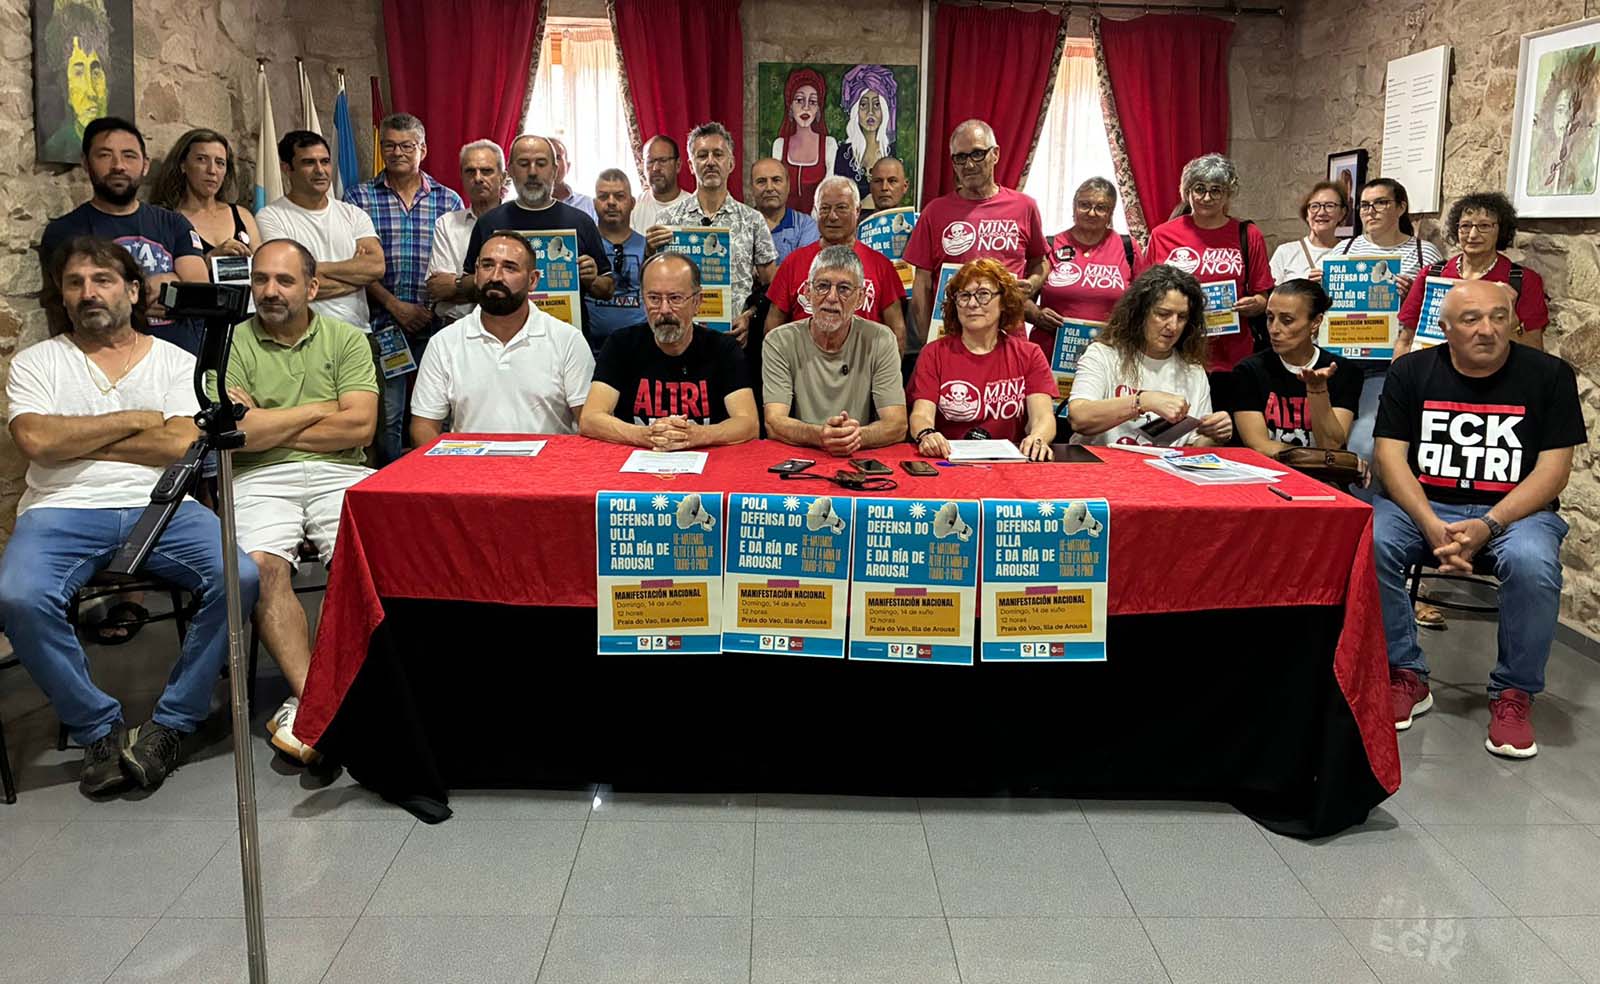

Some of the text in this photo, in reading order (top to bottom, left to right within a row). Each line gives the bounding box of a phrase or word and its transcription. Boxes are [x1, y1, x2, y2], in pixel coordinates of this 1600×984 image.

[978, 222, 1018, 233] MINA
[978, 236, 1018, 250] NON
[692, 246, 701, 254] DO
[1202, 250, 1242, 261] MINA
[1084, 265, 1121, 279] MINA
[1200, 262, 1242, 276] NON
[1081, 276, 1124, 290] NON
[1330, 274, 1368, 282] DEFENSA DO
[1345, 290, 1355, 300] RÍA
[1357, 291, 1366, 300] DE
[1064, 328, 1080, 336] POLA
[1063, 336, 1088, 345] DEFENSA
[1062, 344, 1076, 352] ULLA
[634, 378, 710, 417] ALTRI
[1421, 410, 1524, 448] FCK
[1418, 442, 1523, 482] ALTRI
[610, 499, 635, 511] POLA
[742, 497, 767, 510] POLA
[868, 506, 893, 519] POLA
[996, 505, 1022, 518] POLA
[610, 514, 672, 526] DEFENSA DO
[741, 512, 801, 527] DEFENSA DO
[996, 520, 1058, 532] DEFENSA DO
[610, 528, 635, 540] ULLA
[740, 526, 764, 539] ULLA
[868, 521, 928, 535] DEFENSA DO
[611, 540, 669, 555] E DA RÍA DE
[740, 540, 797, 555] E DA RÍA DE
[867, 535, 891, 548] ULLA
[996, 535, 1020, 547] ULLA
[866, 548, 924, 564] E DA RÍA DE
[996, 546, 1055, 561] E DA RÍA DE
[611, 558, 654, 570] AROUSA!
[739, 555, 781, 569] AROUSA!
[866, 564, 908, 577] AROUSA!
[996, 564, 1039, 576] AROUSA!
[615, 589, 701, 600] MANIFESTACIÓN NACIONAL
[741, 589, 826, 599] MANIFESTACIÓN NACIONAL
[999, 595, 1085, 606] MANIFESTACIÓN NACIONAL
[868, 597, 919, 606] MANIFESTACIÓN
